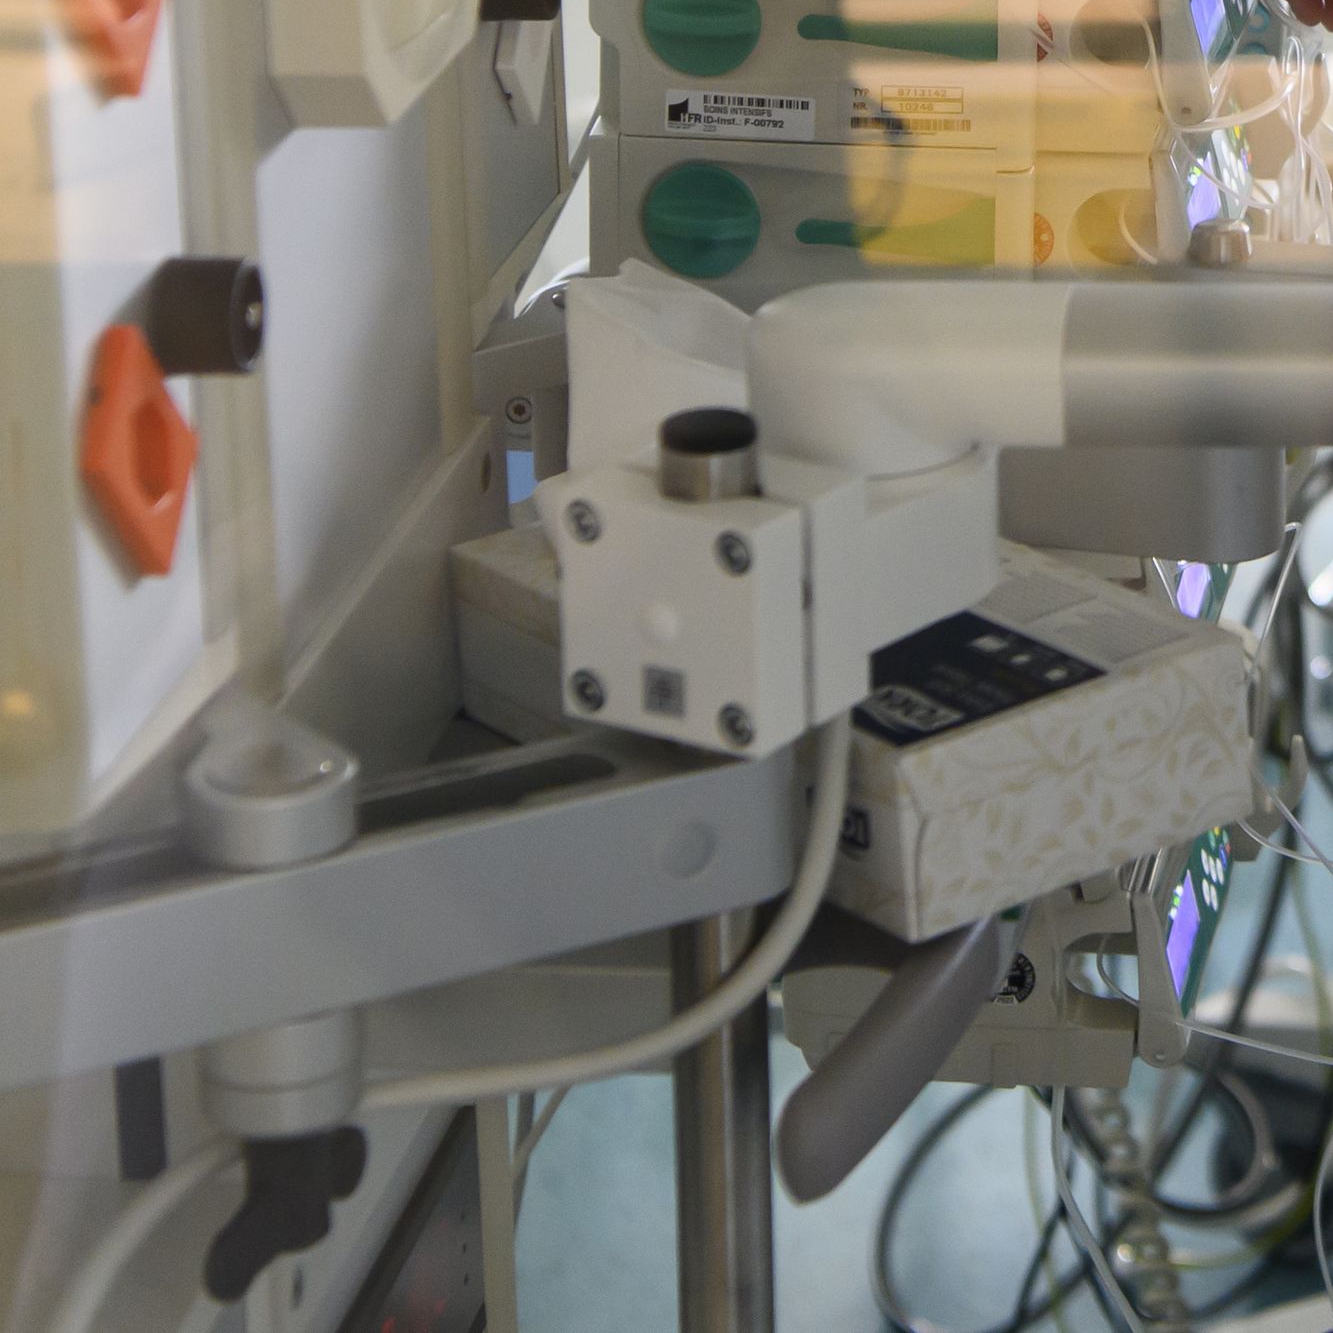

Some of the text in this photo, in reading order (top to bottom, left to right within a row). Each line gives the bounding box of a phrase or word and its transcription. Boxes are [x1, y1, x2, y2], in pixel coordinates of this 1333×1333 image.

[703, 104, 772, 118] SOINS INTENSIFS
[744, 117, 785, 129] F-00792
